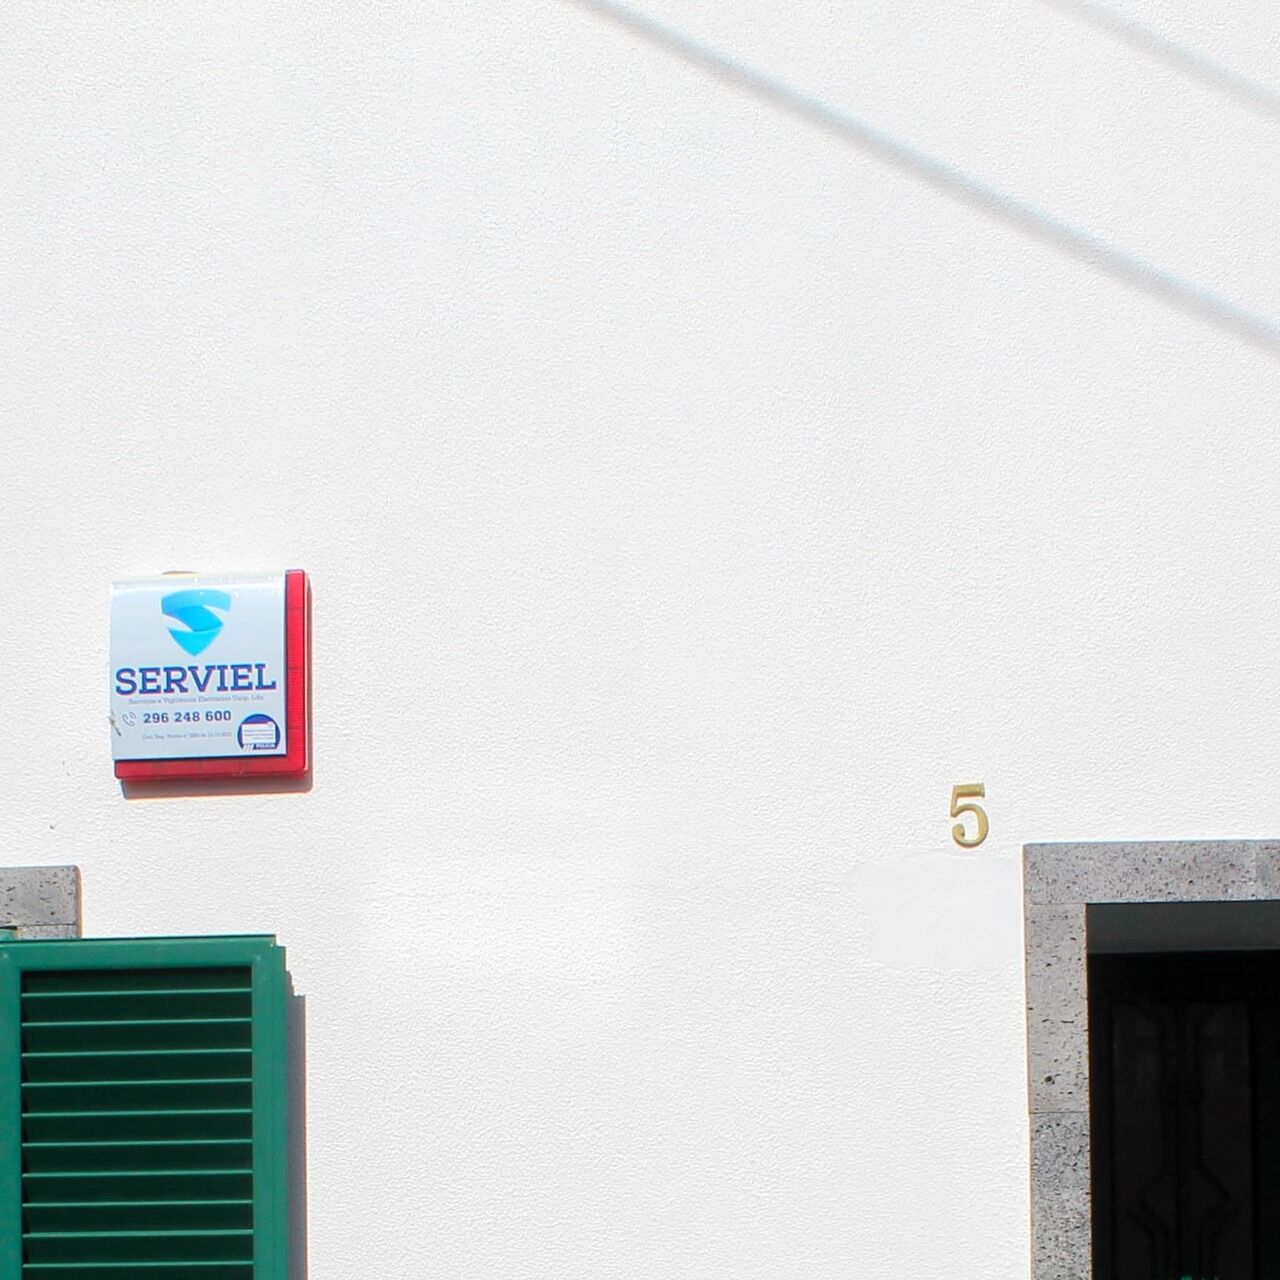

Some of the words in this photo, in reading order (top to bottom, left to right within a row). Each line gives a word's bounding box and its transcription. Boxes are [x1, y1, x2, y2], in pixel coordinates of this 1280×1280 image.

[115, 663, 277, 696] SERVIEL
[143, 712, 169, 724] 296
[174, 711, 201, 723] 248
[205, 710, 232, 722] 600
[950, 782, 989, 849] 5
